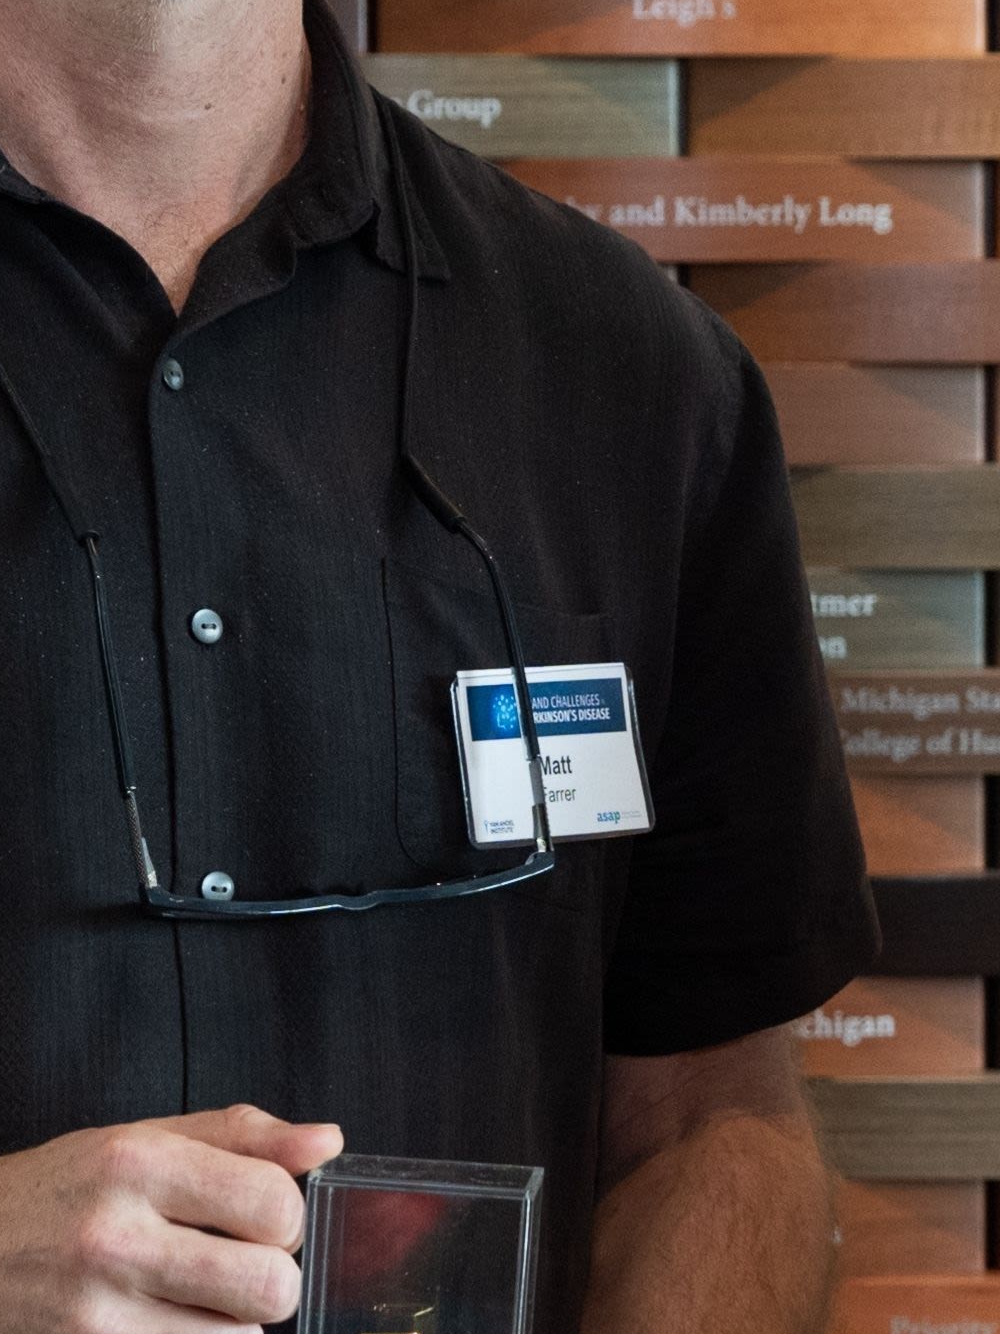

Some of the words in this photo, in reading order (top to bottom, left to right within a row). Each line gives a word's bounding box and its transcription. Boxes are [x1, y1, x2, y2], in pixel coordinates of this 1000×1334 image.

[407, 91, 501, 128] Group
[609, 195, 666, 226] and
[673, 195, 811, 236] Kimberly
[818, 196, 893, 235] Long
[550, 693, 600, 708] CHALLENGES
[578, 707, 610, 723] DISEASE
[841, 687, 960, 721] Michigan
[839, 729, 921, 763] ollege
[926, 727, 955, 755] of
[540, 755, 573, 775] Matt
